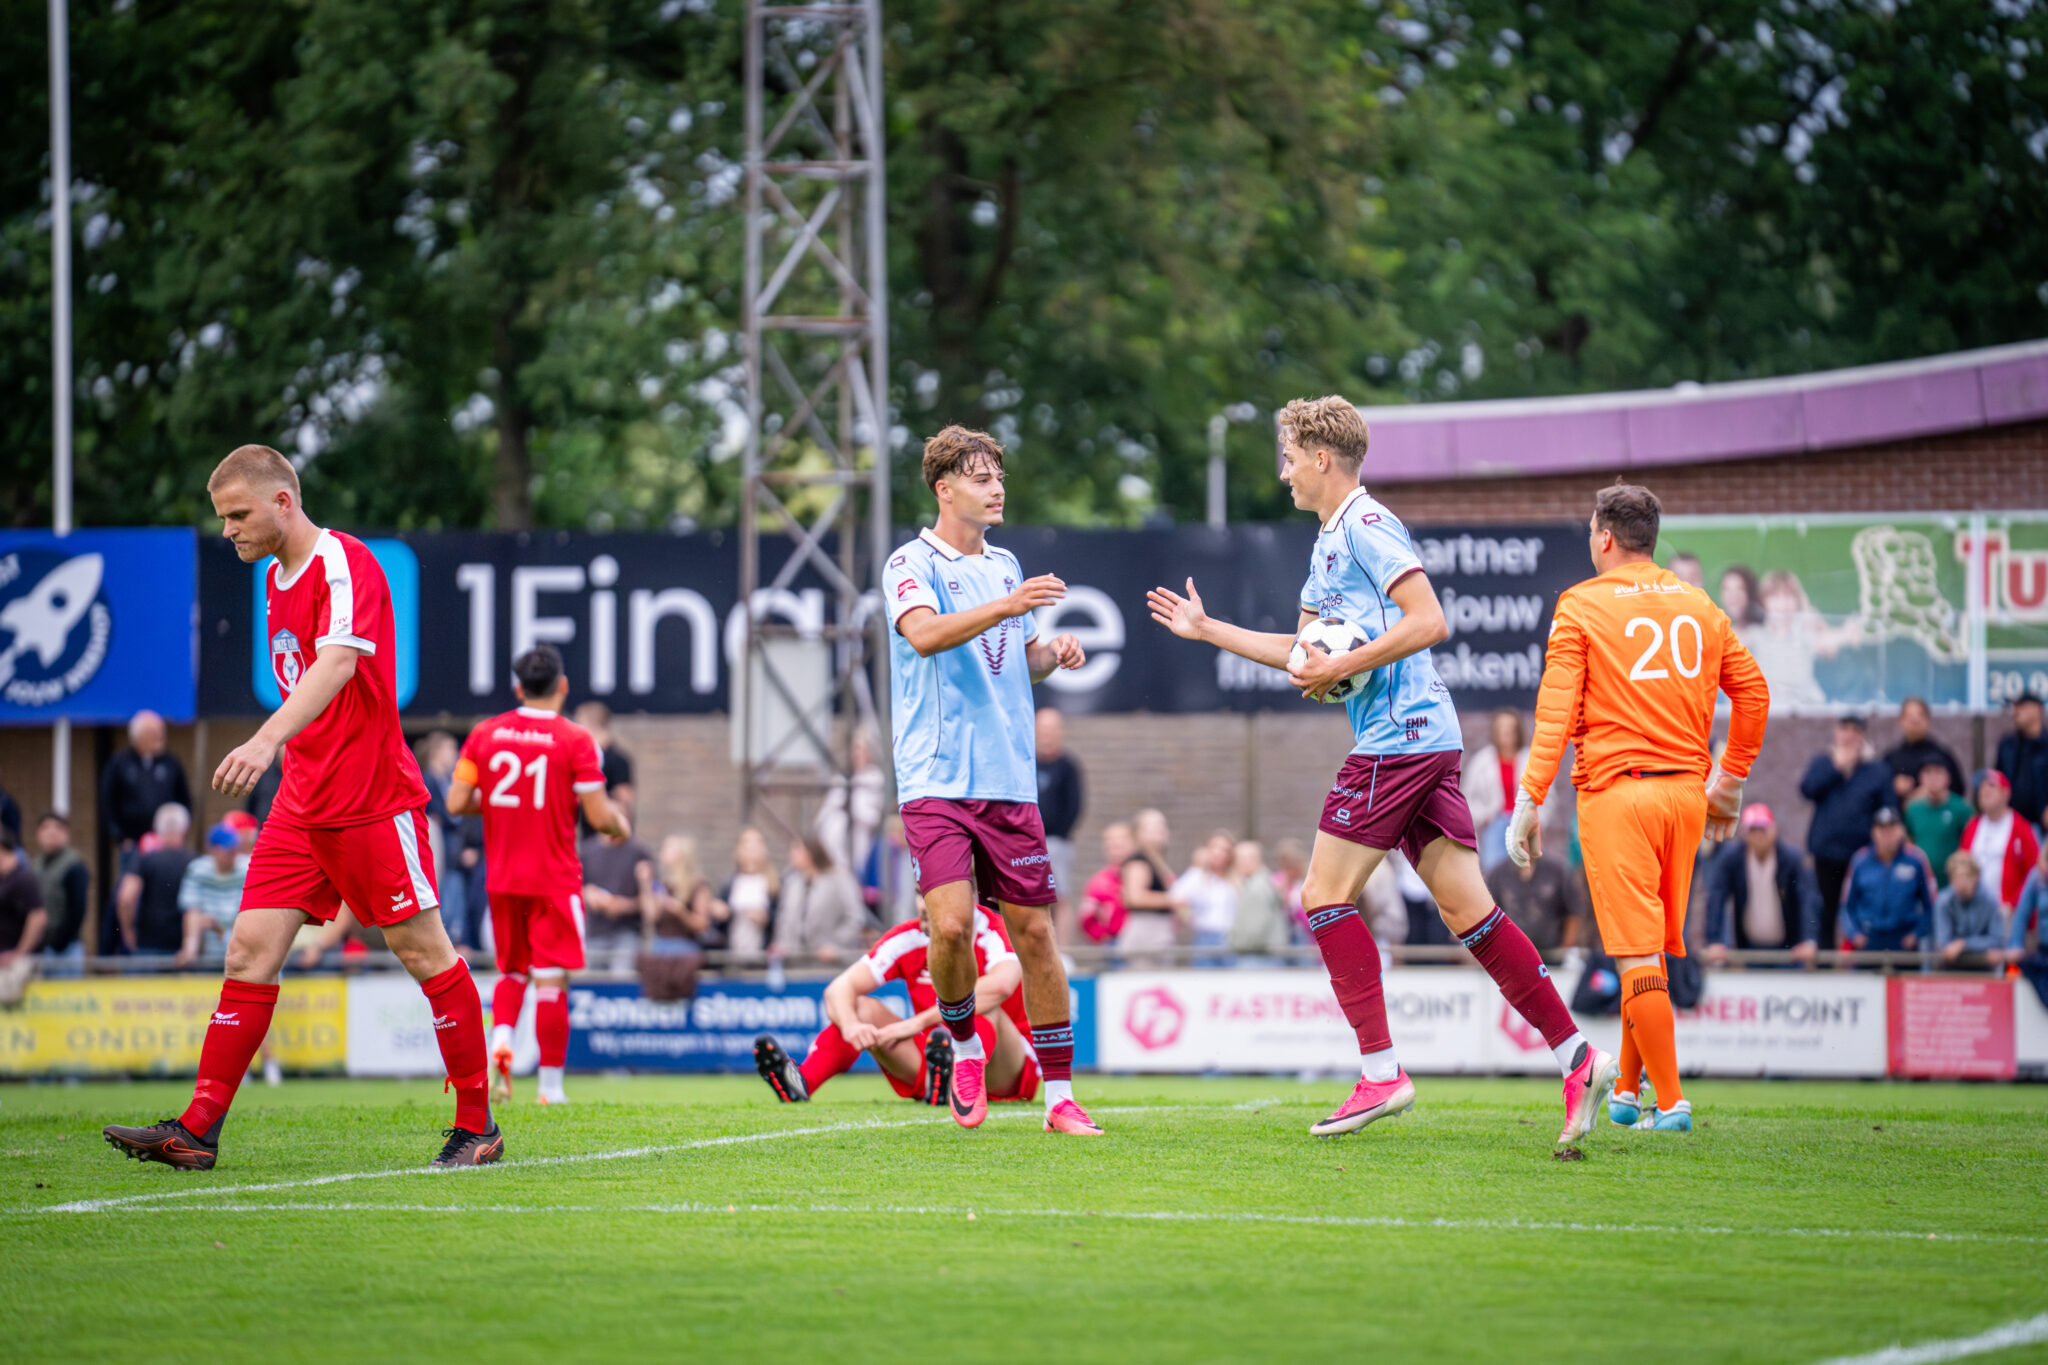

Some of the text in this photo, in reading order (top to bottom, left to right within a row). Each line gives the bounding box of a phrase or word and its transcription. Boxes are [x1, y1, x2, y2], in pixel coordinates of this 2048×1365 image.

[1441, 587, 1543, 641] jouw
[1433, 642, 1541, 690] aken!
[1625, 614, 1703, 680] 20
[1406, 716, 1428, 729] EMM
[1406, 729, 1419, 741] EN
[489, 750, 548, 811] 21
[209, 1018, 240, 1026] rima
